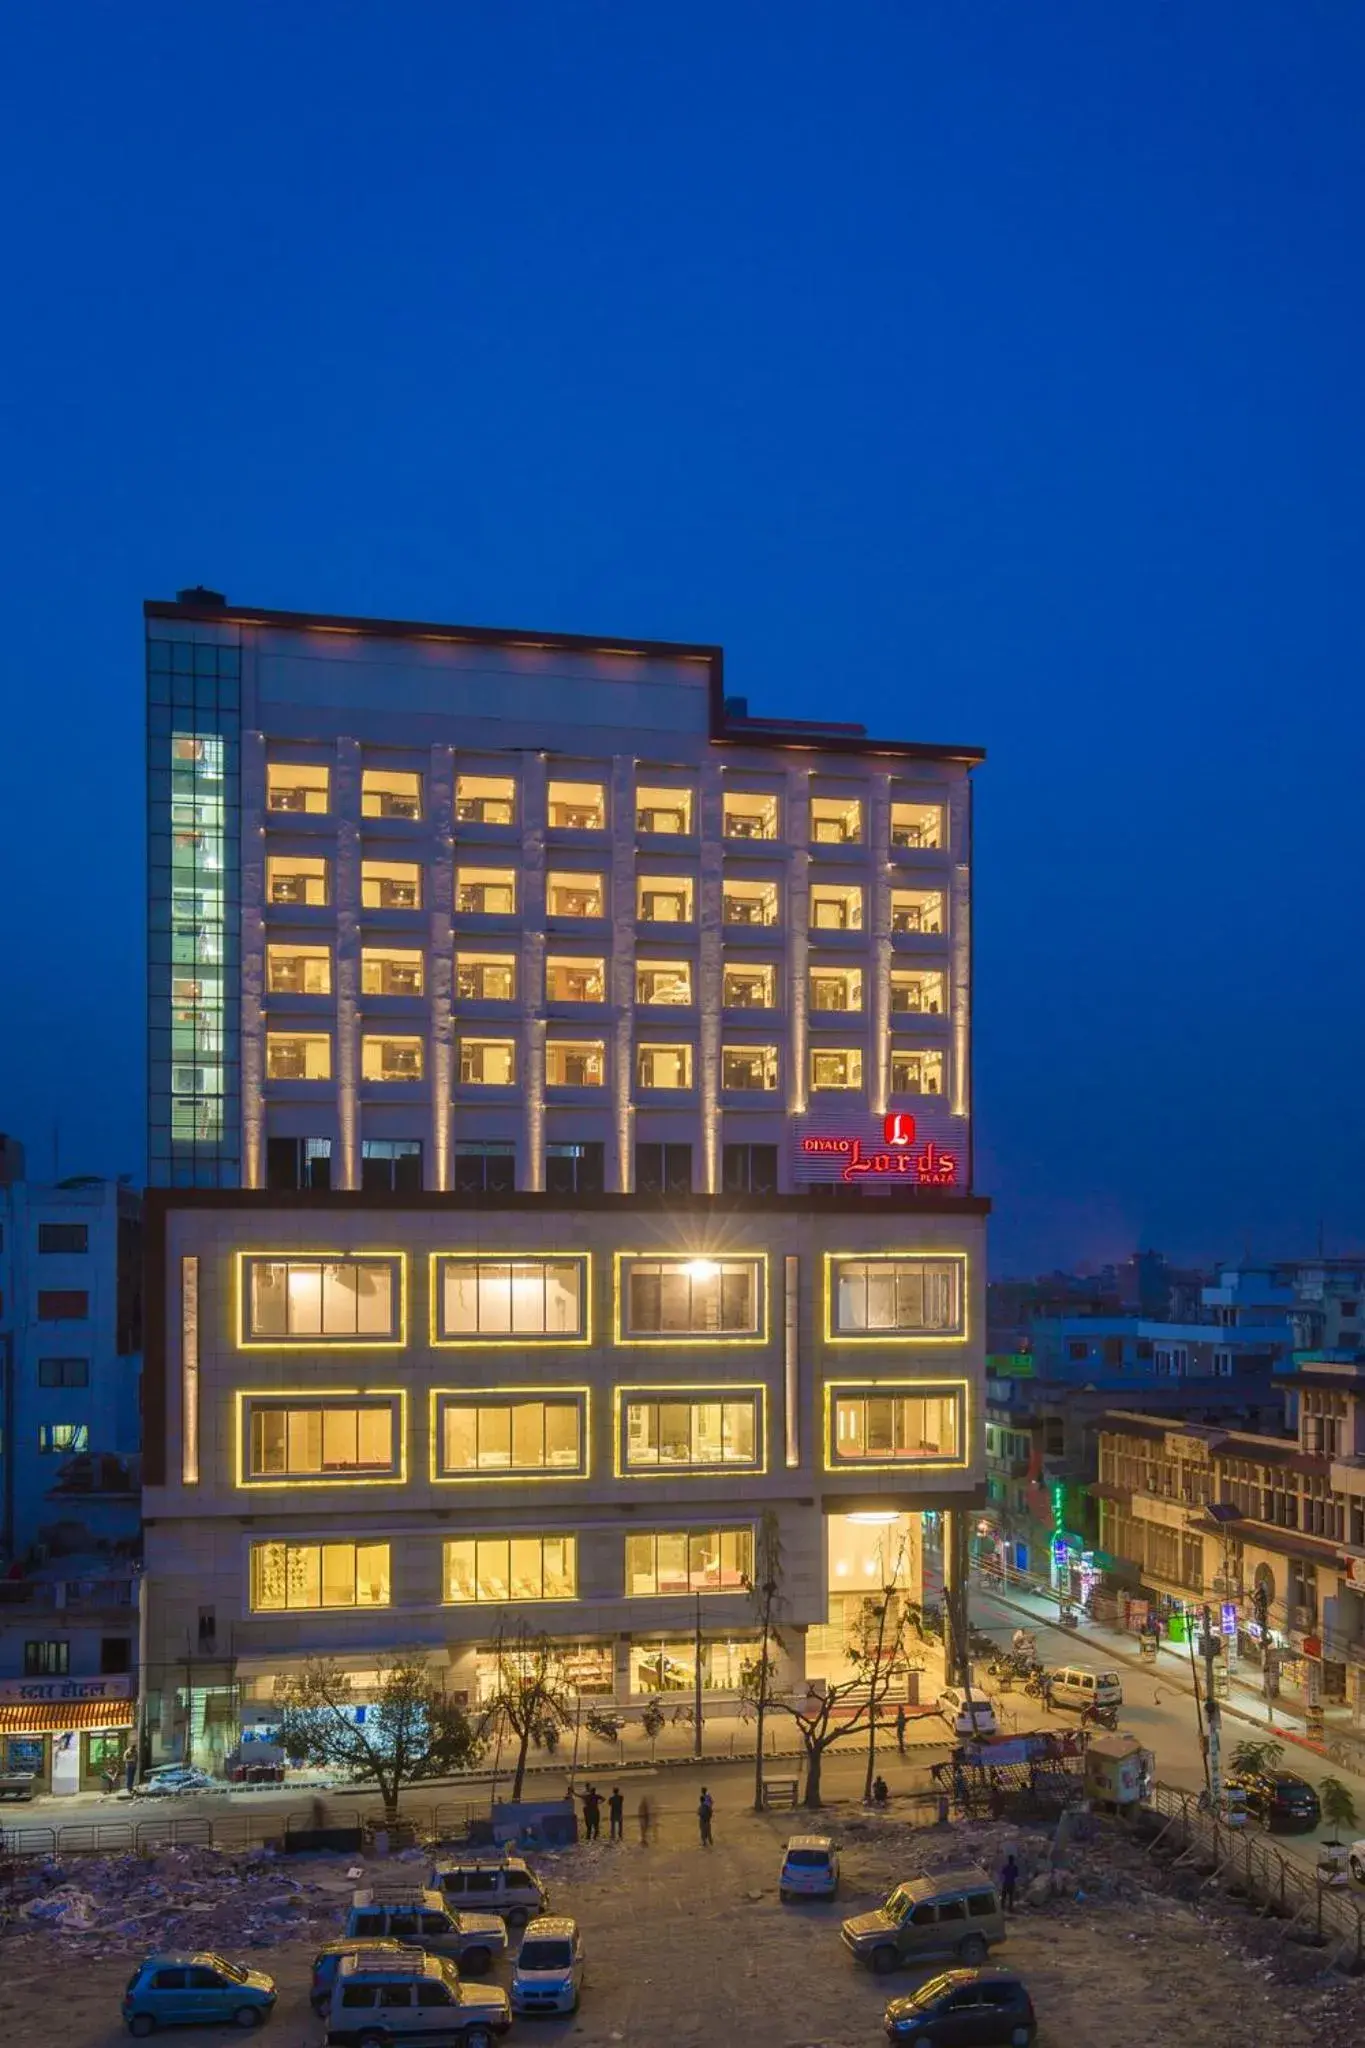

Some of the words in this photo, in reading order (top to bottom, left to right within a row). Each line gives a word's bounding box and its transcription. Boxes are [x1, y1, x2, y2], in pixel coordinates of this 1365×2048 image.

[804, 1139, 849, 1152] DIYALO
[844, 1140, 955, 1181] Lords
[920, 1174, 955, 1183] PLAZA
[58, 1680, 107, 1698] होटल
